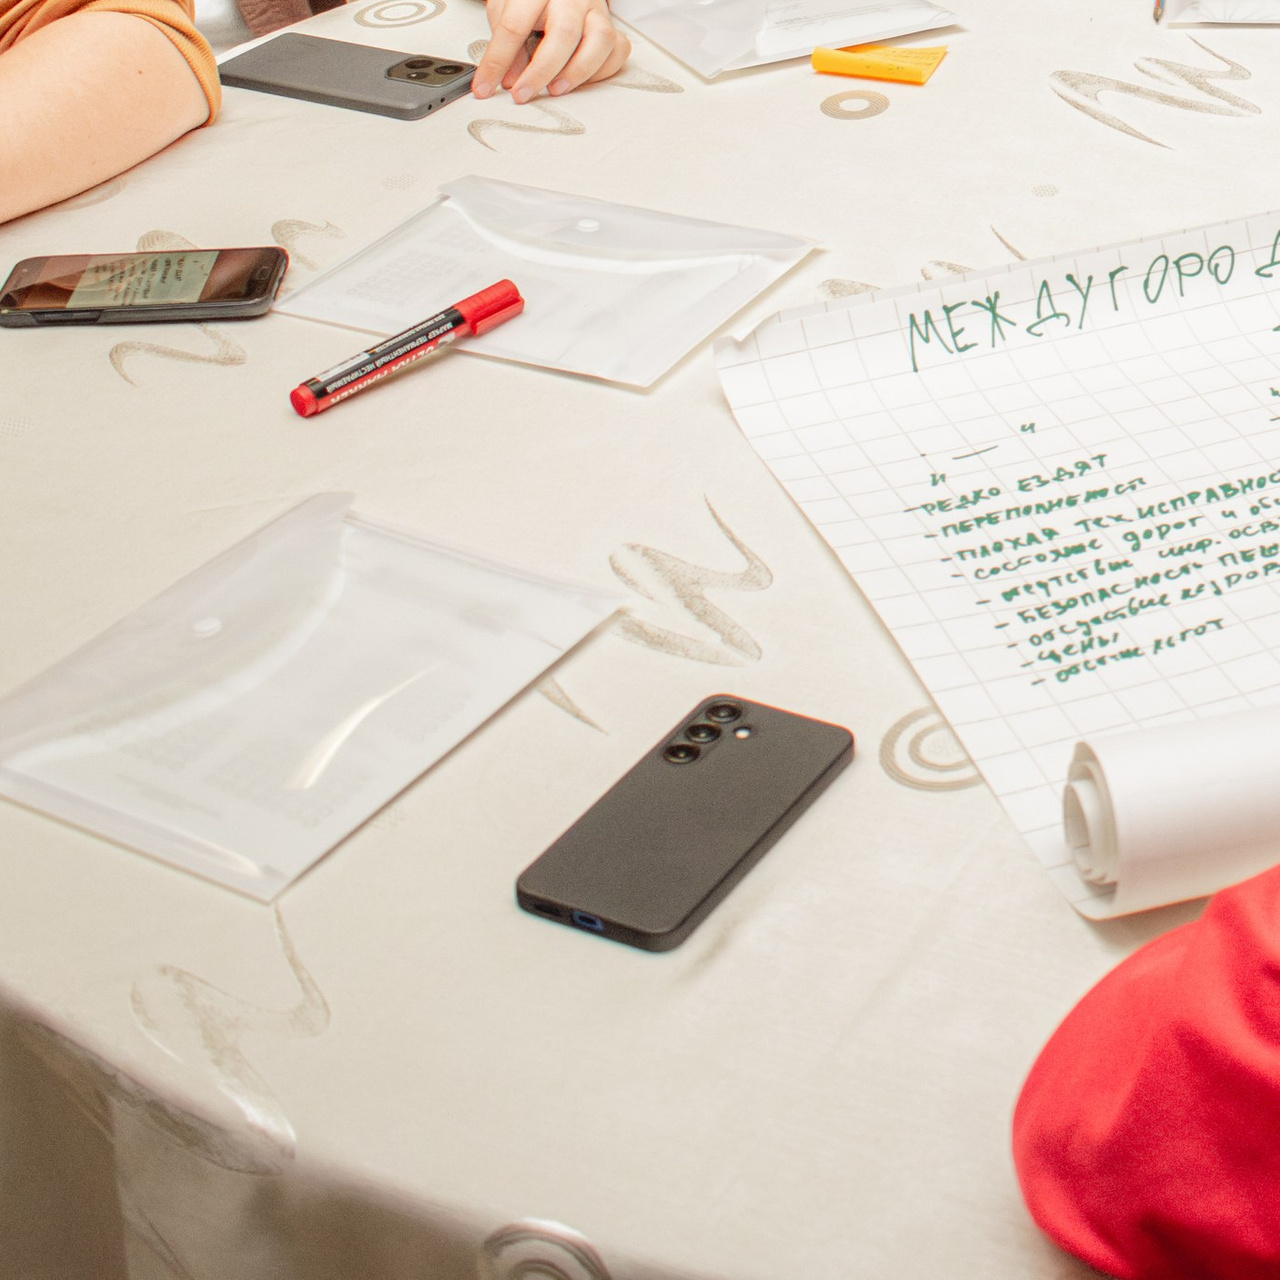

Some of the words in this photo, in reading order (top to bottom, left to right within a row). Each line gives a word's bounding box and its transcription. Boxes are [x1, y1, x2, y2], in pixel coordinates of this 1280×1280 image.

[428, 322, 453, 340] МАРКЕР
[375, 333, 428, 367] ПЕРМАНЕНТНЫЙ
[327, 360, 376, 393] НЕСТИРАЕМЫЙ
[1017, 454, 1107, 492] ЕЗДЯТ
[954, 528, 1060, 561] ПЛОХАЯ
